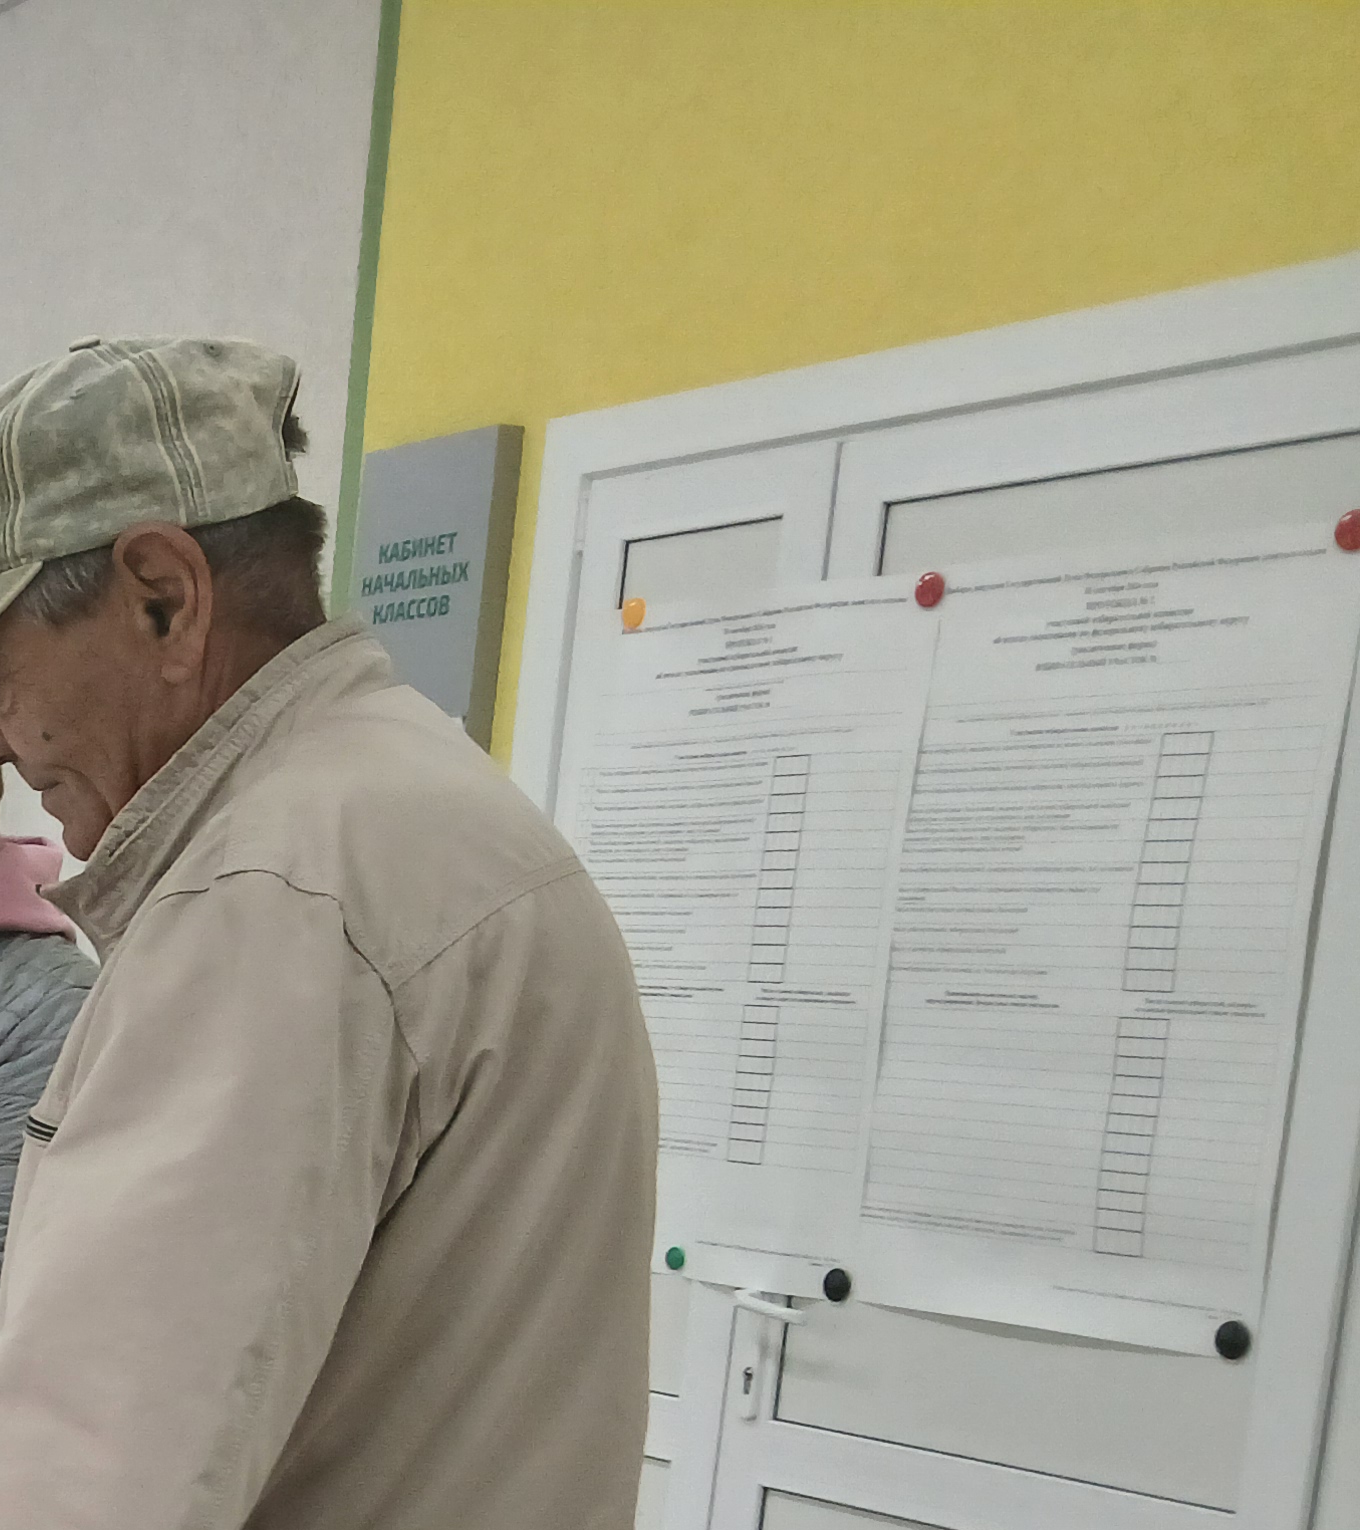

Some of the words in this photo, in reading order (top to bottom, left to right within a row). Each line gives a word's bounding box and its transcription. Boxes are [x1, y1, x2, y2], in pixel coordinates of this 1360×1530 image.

[378, 531, 458, 565] КАБИНЕТ
[361, 561, 471, 597] НАЧАЛЬНЫХ
[372, 594, 451, 625] КЛАССОВ
